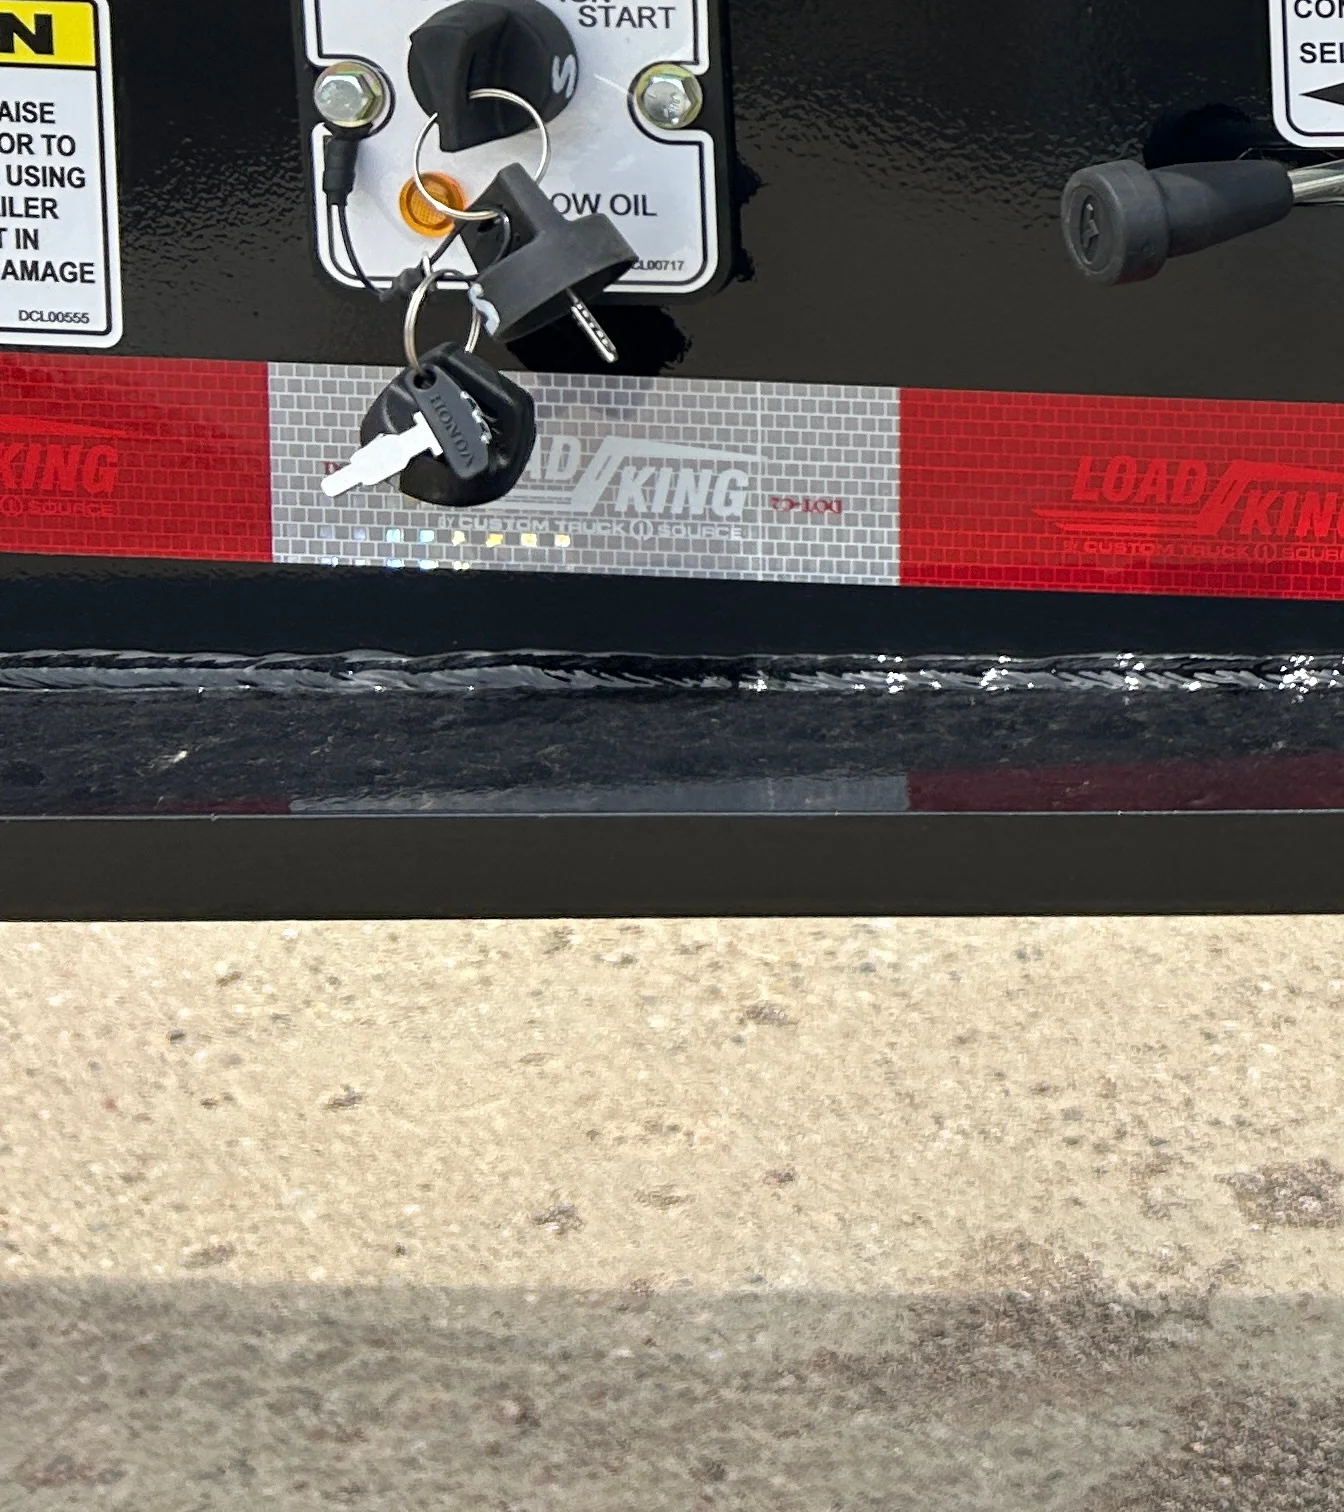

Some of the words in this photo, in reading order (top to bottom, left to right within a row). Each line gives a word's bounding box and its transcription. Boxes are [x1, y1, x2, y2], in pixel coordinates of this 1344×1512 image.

[579, 5, 675, 28] START
[0, 101, 55, 123] AISE
[41, 134, 75, 156] TO
[6, 165, 85, 188] USING
[552, 193, 604, 217] OW
[610, 194, 656, 216] OIL
[15, 229, 39, 250] IN
[1, 260, 95, 283] AMAGE
[19, 310, 89, 324] DCL00555
[429, 391, 474, 469] HONDA
[608, 468, 751, 516] KING
[1071, 455, 1206, 506] LOAD
[460, 516, 548, 533] CUSTOM
[554, 519, 626, 536] TRUCK
[658, 523, 744, 540] SOURCE
